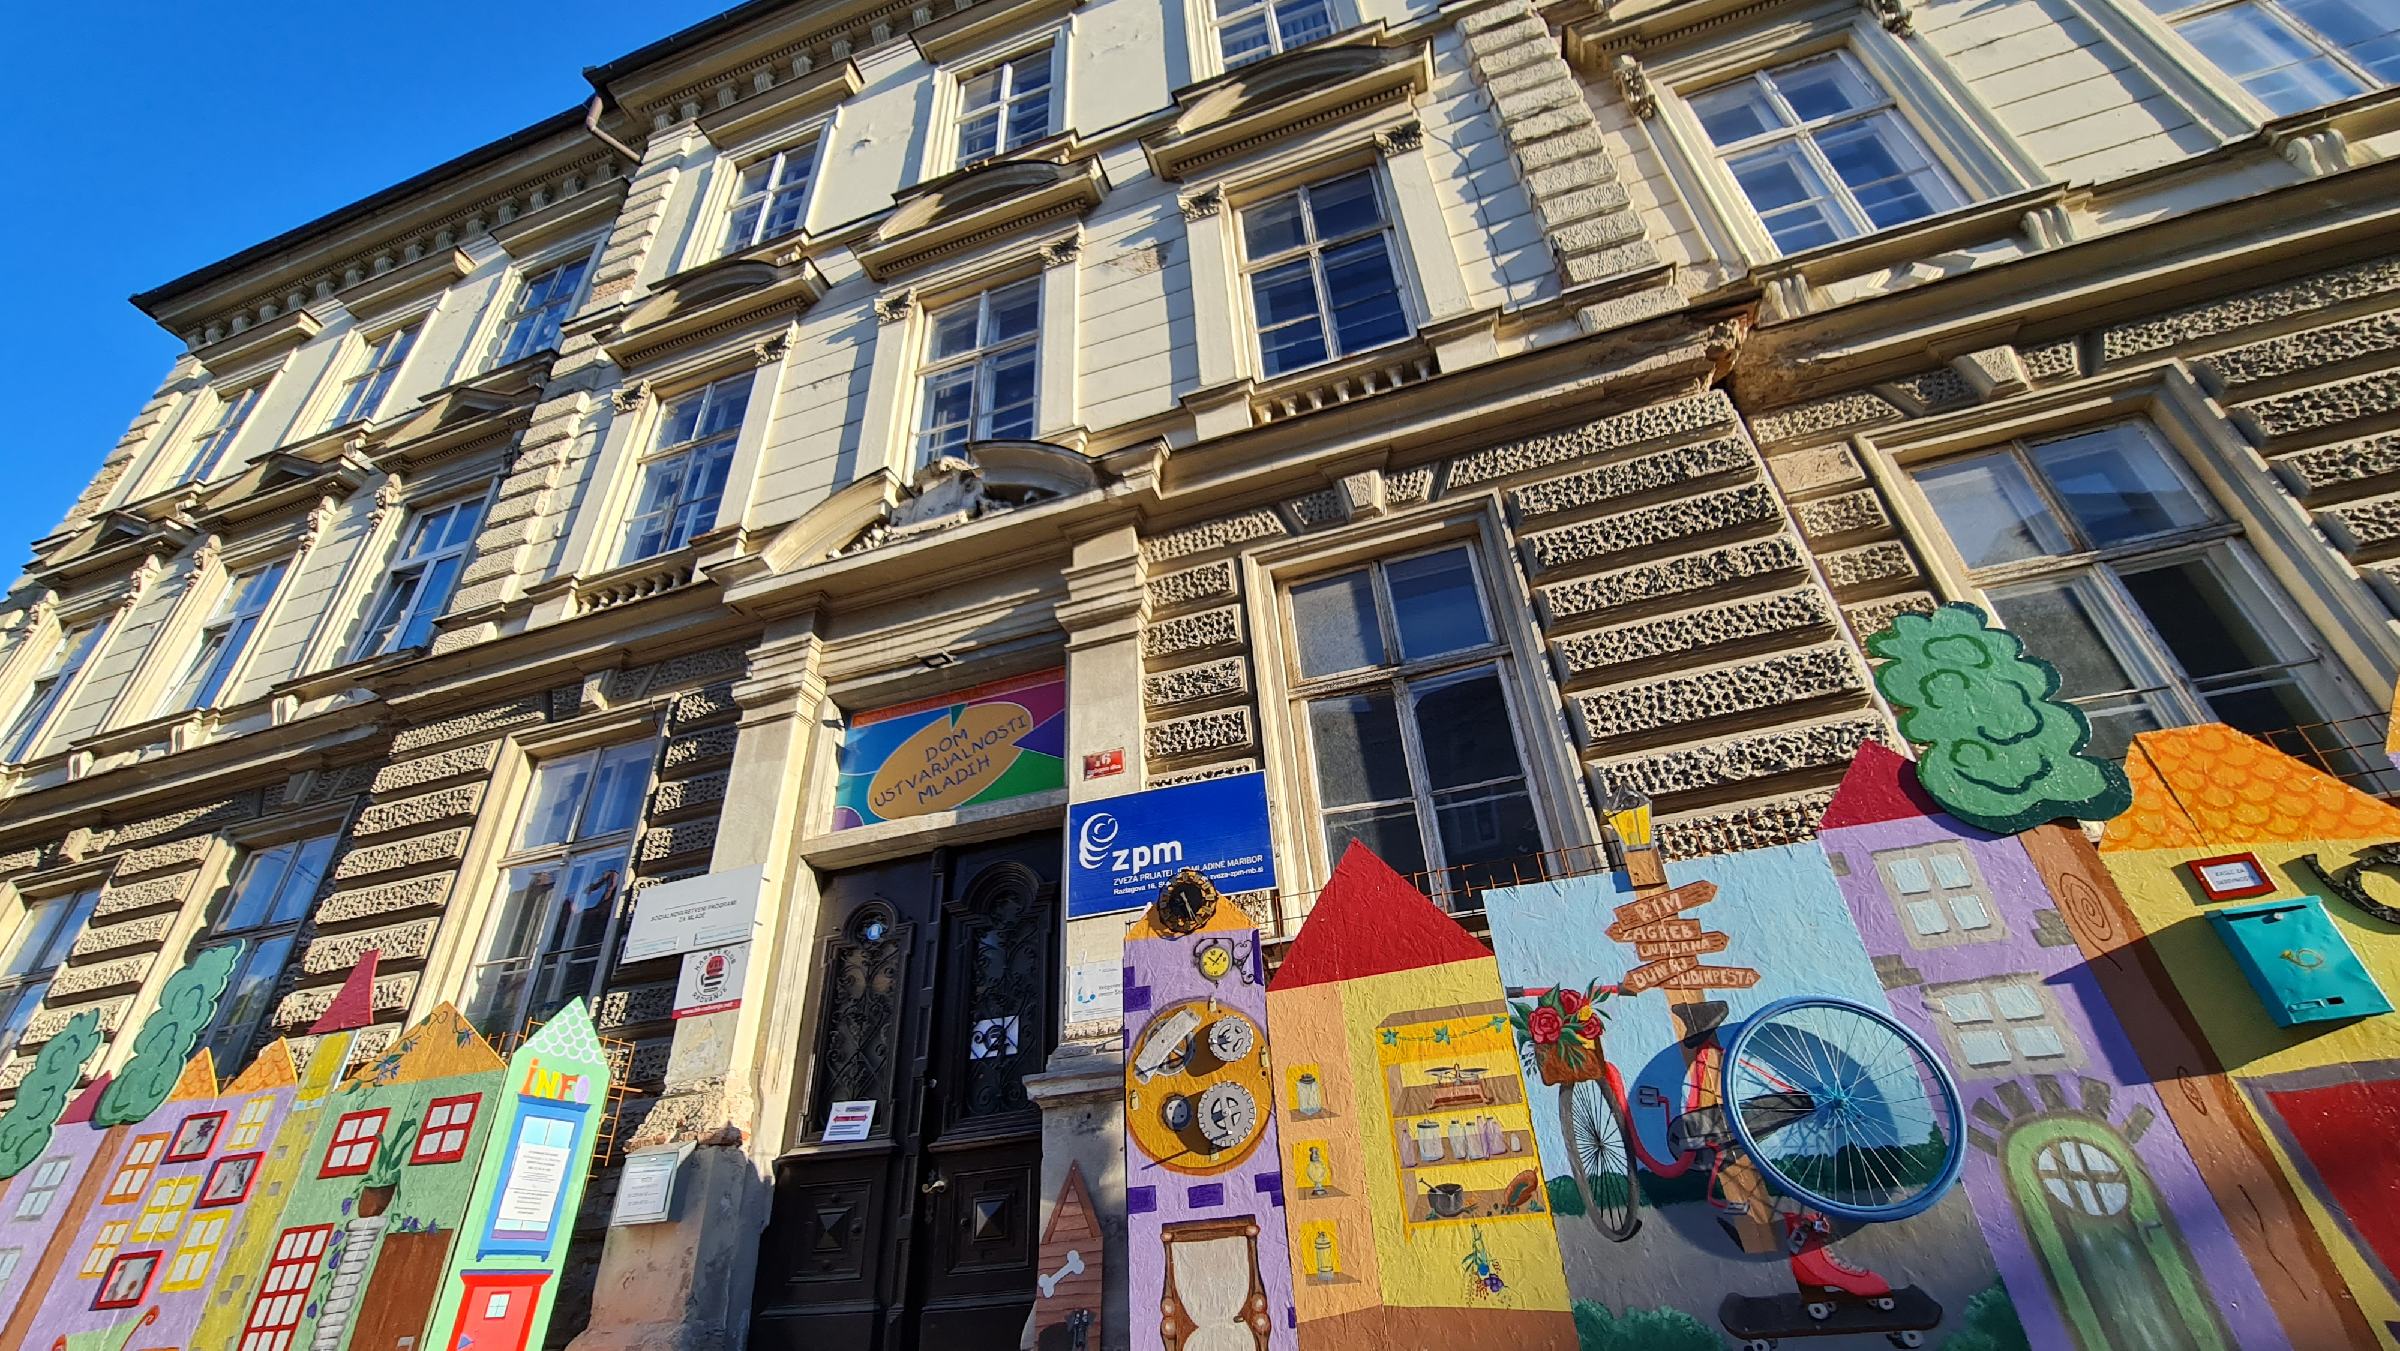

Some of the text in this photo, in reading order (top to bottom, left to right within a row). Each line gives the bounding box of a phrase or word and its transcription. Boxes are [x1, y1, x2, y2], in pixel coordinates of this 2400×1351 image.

[874, 714, 1028, 806] USTVARJALNOSTI
[925, 728, 968, 763] DOM
[918, 754, 990, 805] MLADIH
[1111, 840, 1183, 875] zpm
[1113, 875, 1138, 886] ZVEZA
[1227, 854, 1263, 867] MARIBOR
[1633, 892, 1683, 922] RIM
[1620, 924, 1694, 941] ZAGREB
[1639, 938, 1711, 957] LJUBLJANA
[1632, 958, 1689, 989] DUNAJ
